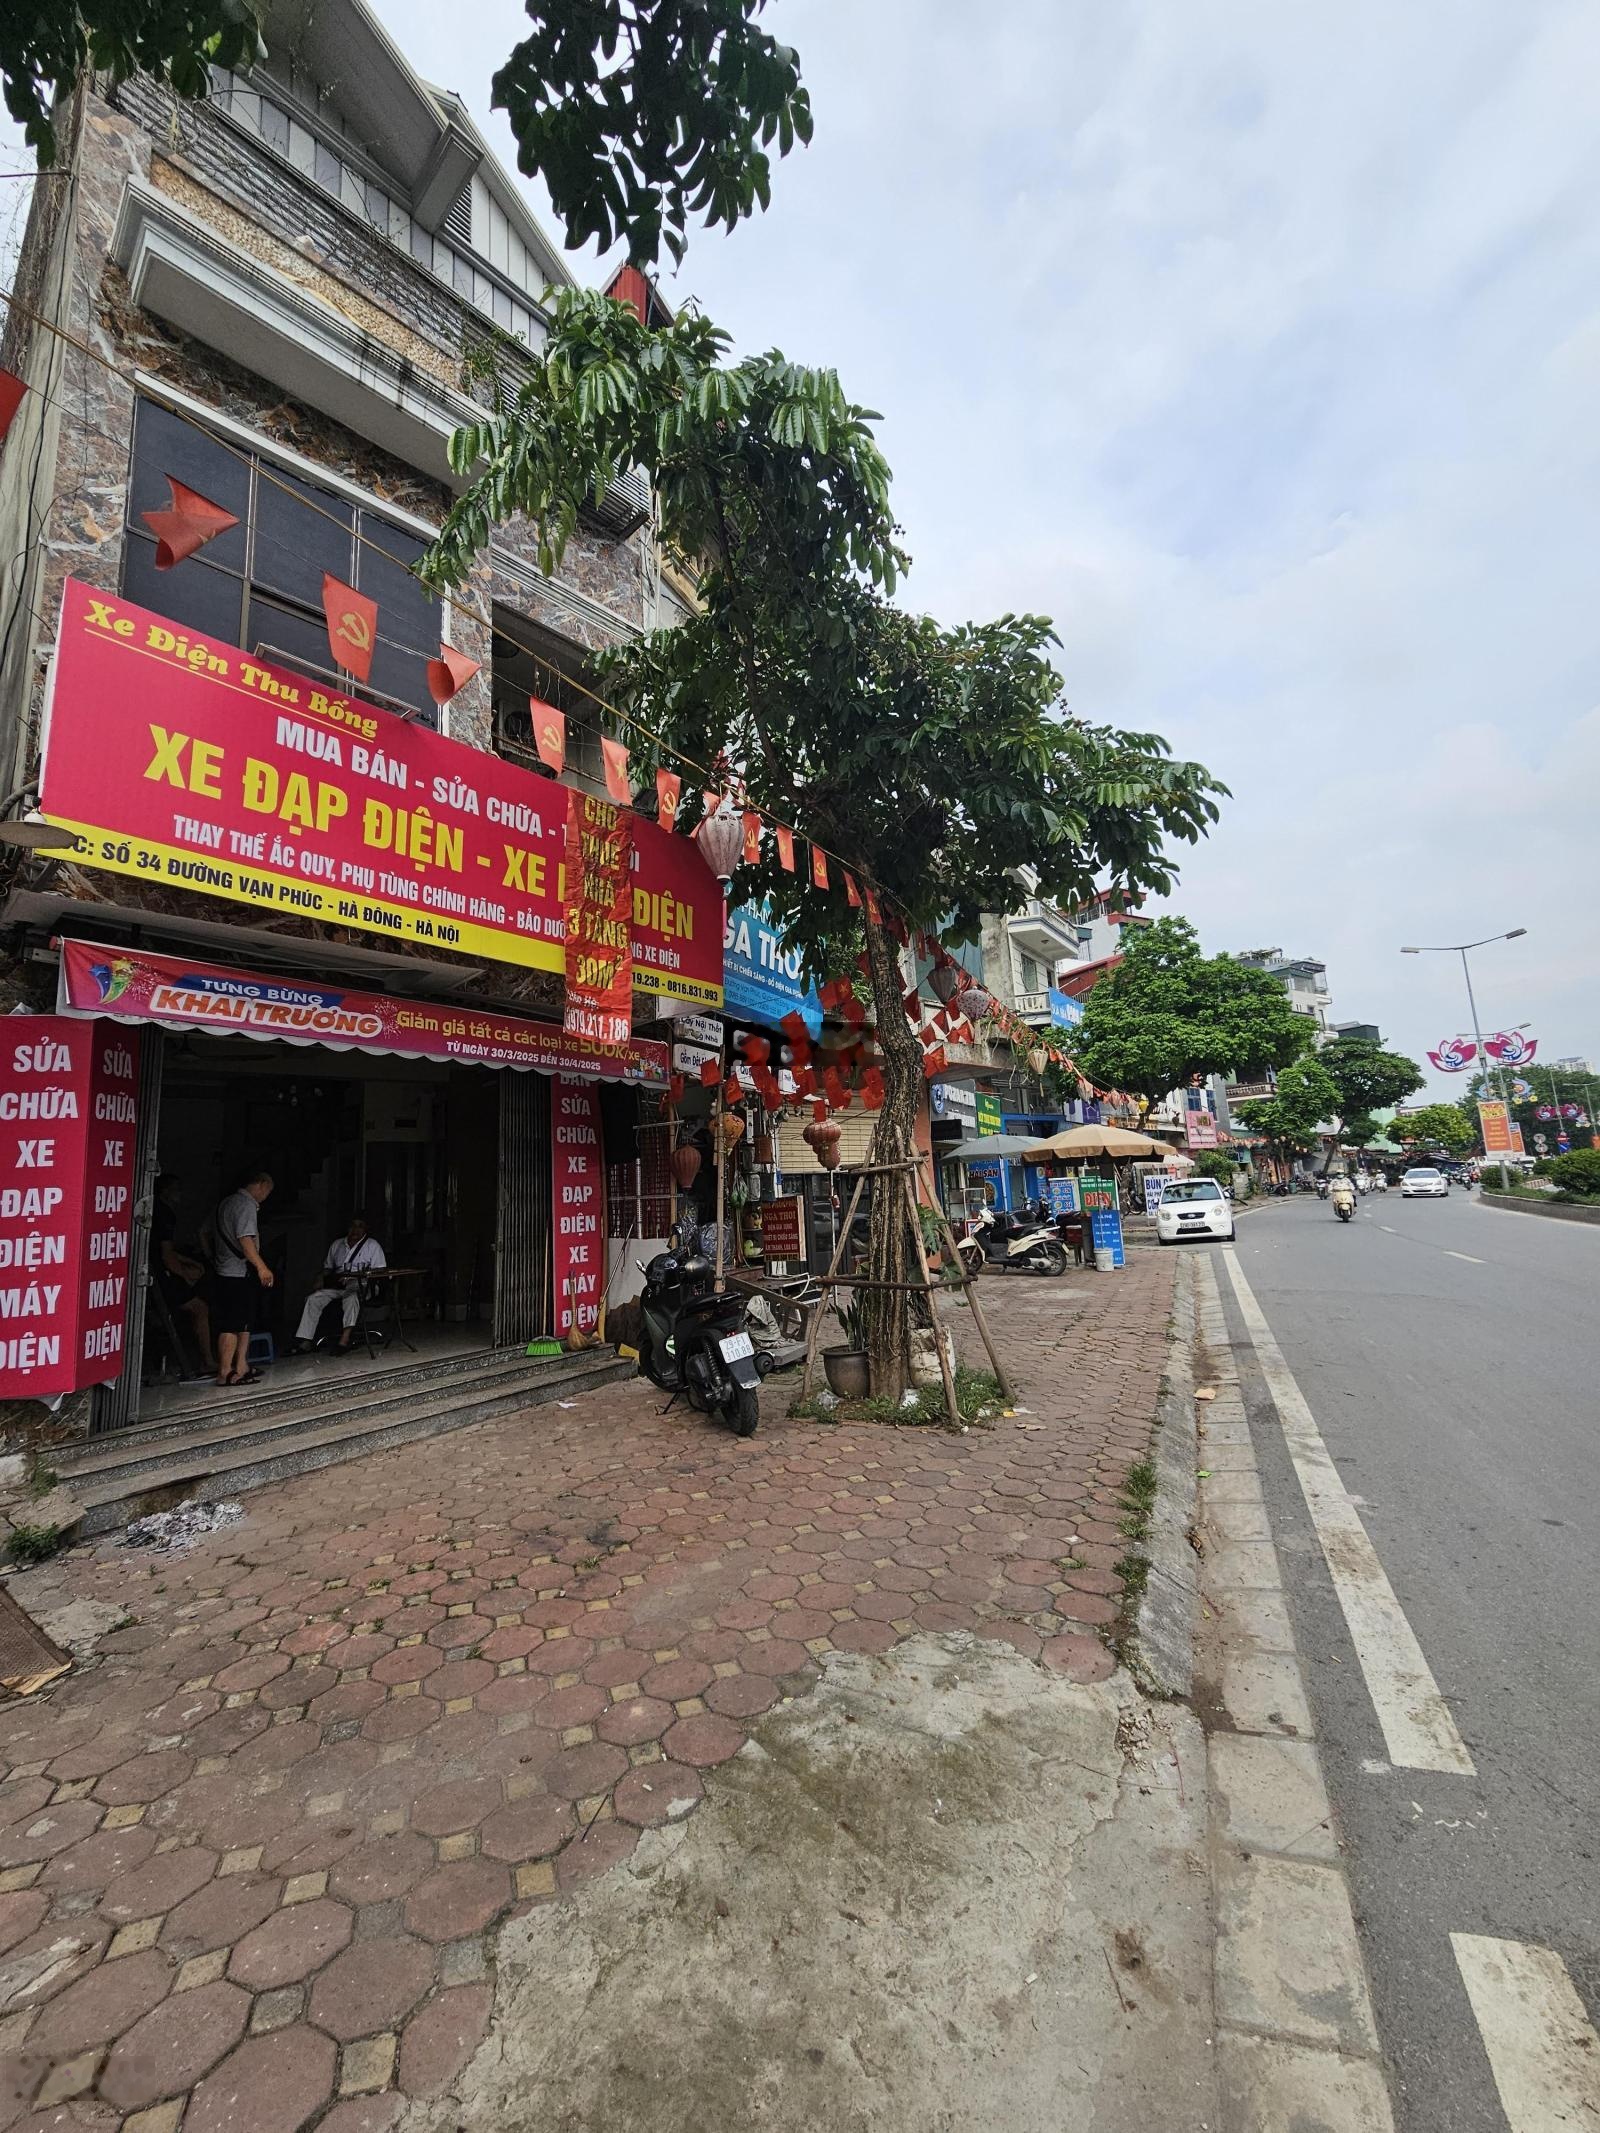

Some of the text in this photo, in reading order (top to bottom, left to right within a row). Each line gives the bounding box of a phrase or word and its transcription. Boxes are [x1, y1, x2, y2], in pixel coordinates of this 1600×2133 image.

[84, 600, 377, 738] Xe Điện Thu Bống
[276, 716, 342, 766] MUA
[352, 745, 407, 789] BÁN
[433, 776, 479, 816] SỬA
[487, 797, 542, 838] CHỮA
[143, 724, 224, 799] XE
[243, 757, 348, 836] ĐẠP
[363, 798, 463, 872] ĐIỆN
[502, 844, 546, 897] XE
[584, 796, 617, 831] CHO
[581, 831, 620, 871] THUÊ
[73, 835, 94, 856] C:
[101, 841, 132, 863] SỐ
[136, 851, 161, 871] 34
[168, 858, 233, 889] ĐƯỜNG
[239, 876, 274, 899] VẠN
[279, 886, 322, 910] PHÚC
[339, 900, 358, 919] HÀ
[363, 907, 402, 930] ĐÔNG
[416, 917, 433, 937] HÀ
[437, 925, 460, 945] NỘI
[174, 814, 224, 848] THAY
[230, 832, 266, 860] THẾ
[270, 835, 295, 868] ẮC
[300, 851, 336, 882] QUY,
[341, 861, 375, 893] PHỤ
[379, 870, 418, 902] TÙNG
[422, 885, 466, 914] CHÍNH
[470, 897, 505, 924] HÃNG
[517, 907, 541, 933] BẢO
[583, 873, 615, 907] NHÀ
[568, 908, 628, 949] 3 TẦNG
[633, 888, 693, 942] ĐIỆN
[645, 945, 657, 963] XE
[659, 948, 680, 970] ĐIỆN
[201, 979, 323, 1004] TƯNG BỪNG
[667, 980, 718, 1002] 0816.831.993
[156, 989, 380, 1036] KHAI TRƯƠNG
[695, 1018, 707, 1030] Nội
[397, 1011, 438, 1031] Giảm
[442, 1019, 465, 1036] giá
[469, 1021, 491, 1039] tất
[494, 1027, 510, 1042] cả
[514, 1031, 536, 1045] các
[539, 1033, 561, 1051] loại
[565, 1040, 578, 1052] xe
[13, 1036, 72, 1073] SỬA
[103, 1043, 133, 1079] SỬA
[446, 1041, 601, 1071] TỪ NGÀY 30/3/2025 ĐẾN 30/4/2025
[0, 1086, 79, 1120] CHỮA
[95, 1091, 136, 1123] CHỮA
[561, 1093, 591, 1116] SỬA
[557, 1124, 597, 1145] CHỮA
[15, 1139, 55, 1168] XE
[103, 1140, 124, 1167] XE
[568, 1156, 587, 1173] XE
[562, 1186, 593, 1207] ĐẠP
[1146, 1177, 1161, 1190] BÚN
[0, 1187, 63, 1222] ĐẠP
[95, 1186, 127, 1218] ĐẠP
[560, 1213, 596, 1236] ĐIỆN
[0, 1231, 66, 1273] ĐIỆN
[90, 1227, 128, 1265] ĐIỆN
[569, 1245, 588, 1264] XE
[0, 1281, 61, 1319] MÁY
[88, 1273, 125, 1309] MÁY
[562, 1273, 596, 1296] MÁY
[561, 1303, 598, 1328] ĐỆN
[84, 1320, 122, 1361] ĐIỆN
